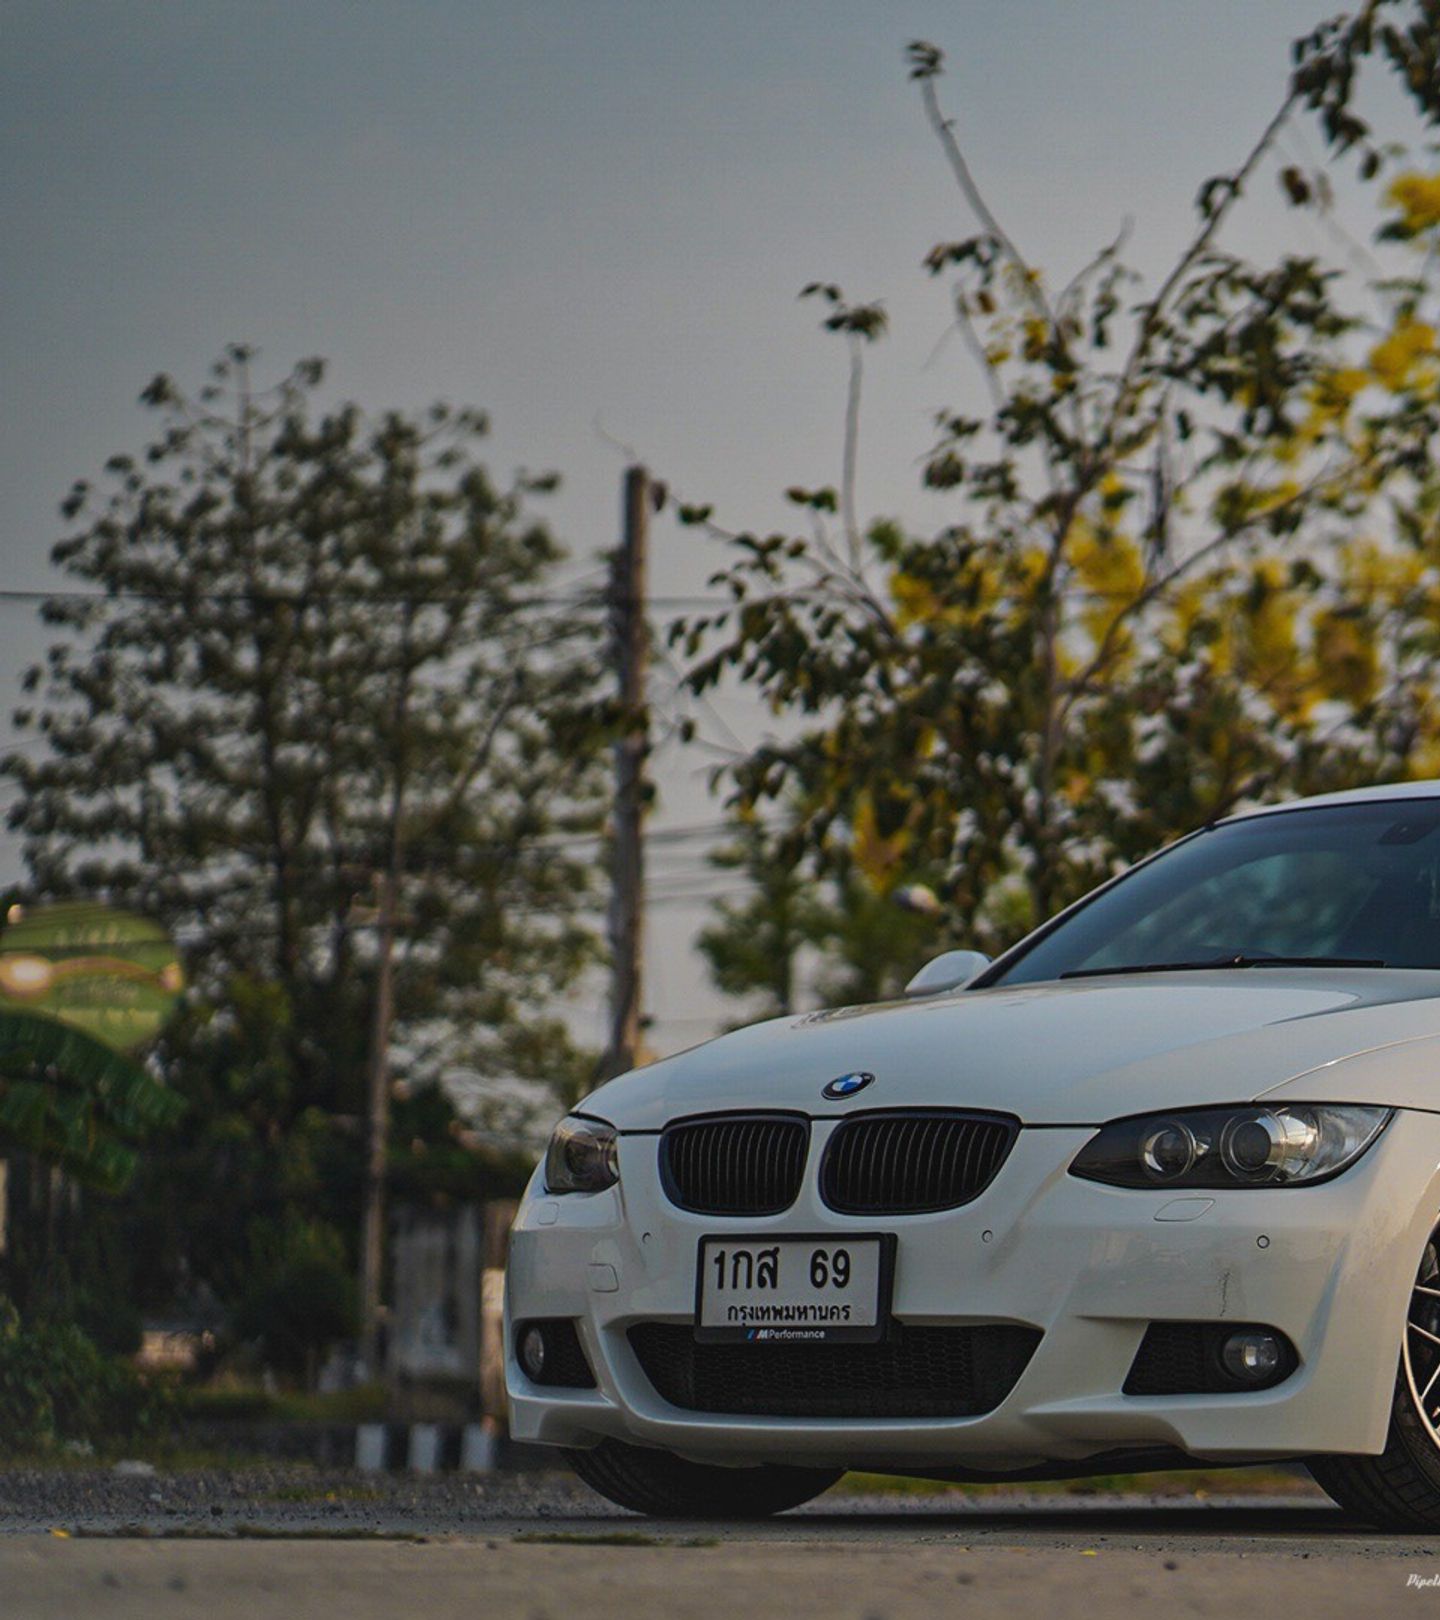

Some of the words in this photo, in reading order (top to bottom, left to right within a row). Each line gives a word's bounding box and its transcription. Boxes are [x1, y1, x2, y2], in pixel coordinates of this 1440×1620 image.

[714, 1246, 780, 1289] 1กส
[810, 1248, 850, 1289] 69
[727, 1304, 851, 1327] กรุงเทพมหานคร
